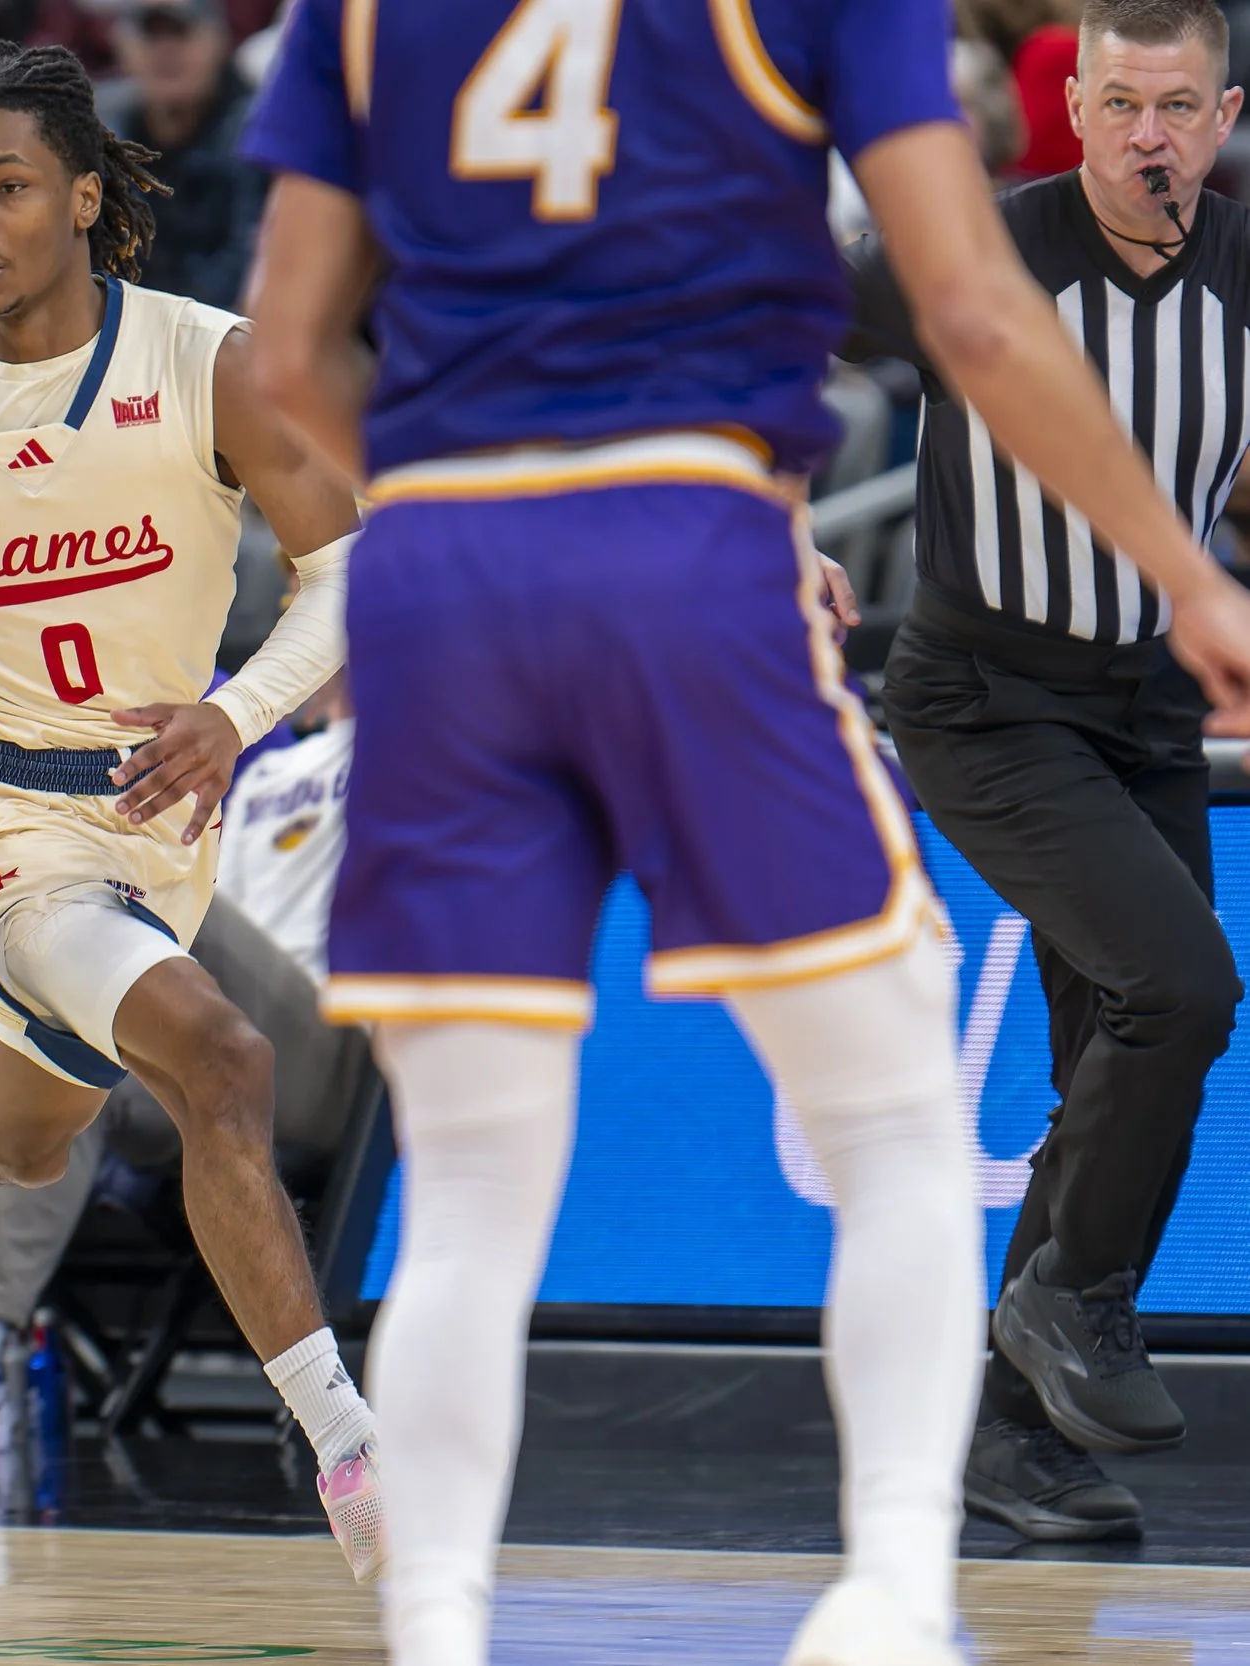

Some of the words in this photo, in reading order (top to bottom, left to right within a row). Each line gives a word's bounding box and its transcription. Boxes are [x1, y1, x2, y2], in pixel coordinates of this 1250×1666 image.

[449, 0, 622, 223] 4
[111, 390, 160, 424] VALLEY
[41, 622, 104, 704] 0
